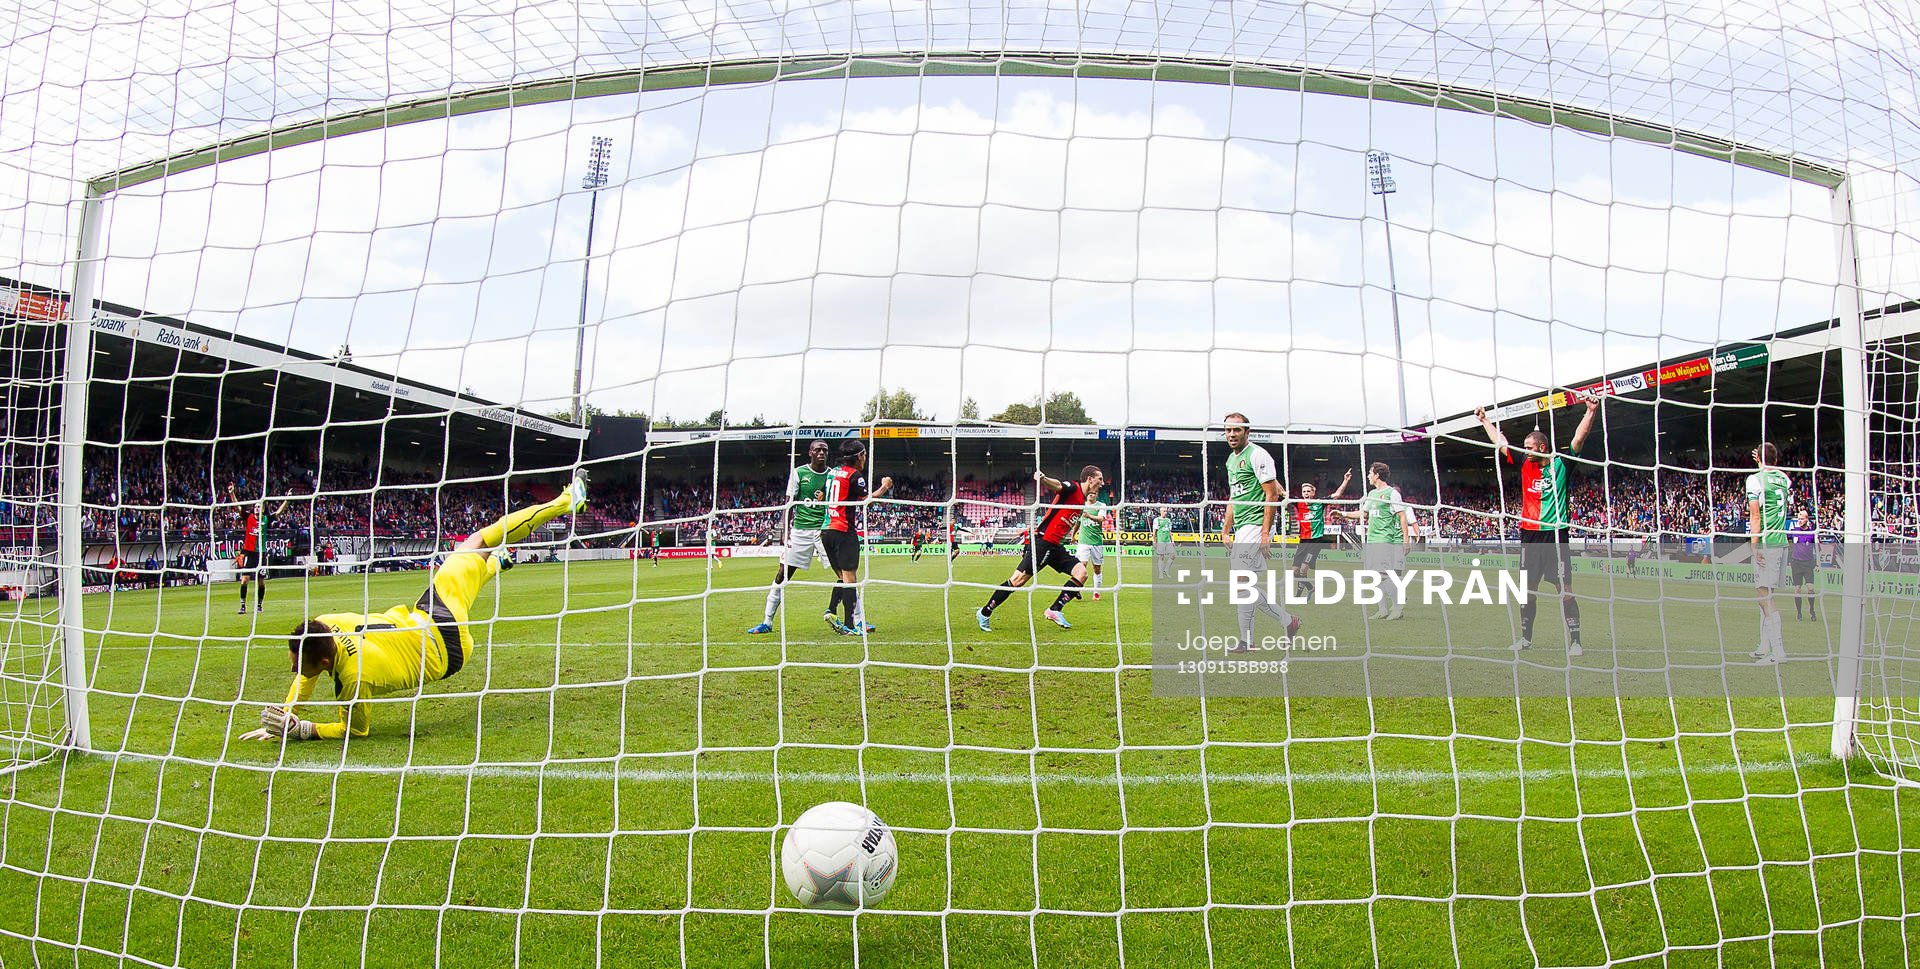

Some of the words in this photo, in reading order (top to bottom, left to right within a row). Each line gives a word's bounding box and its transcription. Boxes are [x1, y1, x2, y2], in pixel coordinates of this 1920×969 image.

[1676, 364, 1700, 377] Weijers
[488, 409, 517, 423] Gelderlandr
[825, 479, 840, 508] 10
[1101, 532, 1130, 540] AUO
[1819, 553, 1832, 563] EC
[1727, 572, 1735, 582] IN
[331, 624, 357, 656] muler
